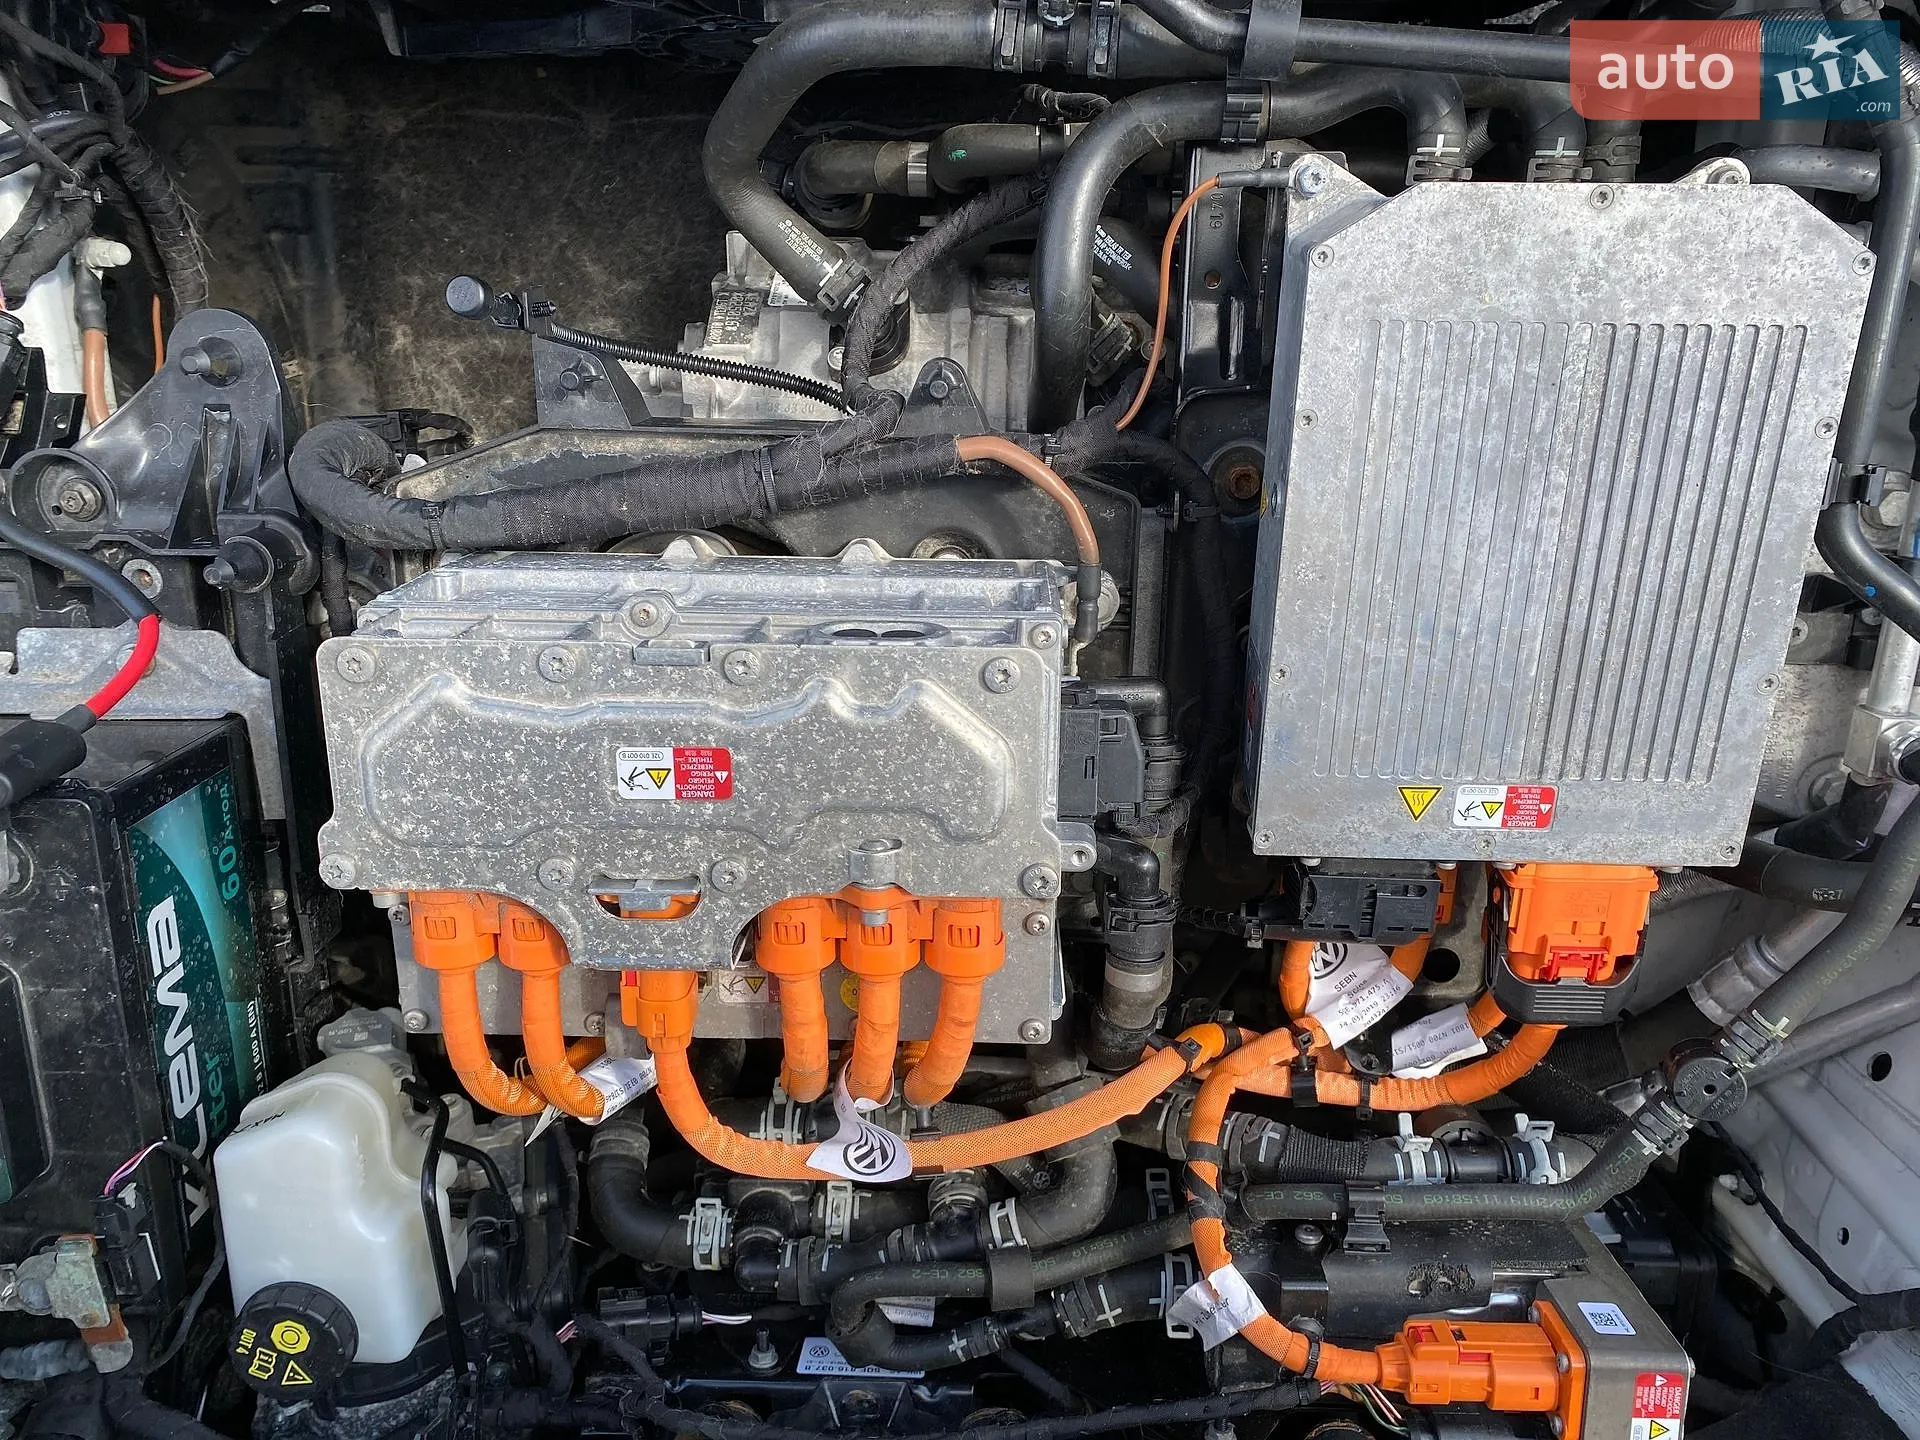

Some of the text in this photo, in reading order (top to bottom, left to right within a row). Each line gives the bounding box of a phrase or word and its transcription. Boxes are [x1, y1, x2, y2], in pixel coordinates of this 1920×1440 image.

[681, 790, 715, 798] DANGER
[218, 846, 240, 900] 60
[1332, 971, 1360, 993] SEBN
[247, 1001, 257, 1027] (EN)
[1451, 1023, 1469, 1034] 1801
[1428, 1031, 1448, 1043] N700
[251, 1039, 261, 1063] 600
[1245, 1191, 1284, 1202] CE-2
[1292, 1191, 1323, 1201] 362
[912, 1269, 947, 1279] CE-2
[958, 1268, 984, 1278] 362
[1673, 1387, 1682, 1414] DANGER
